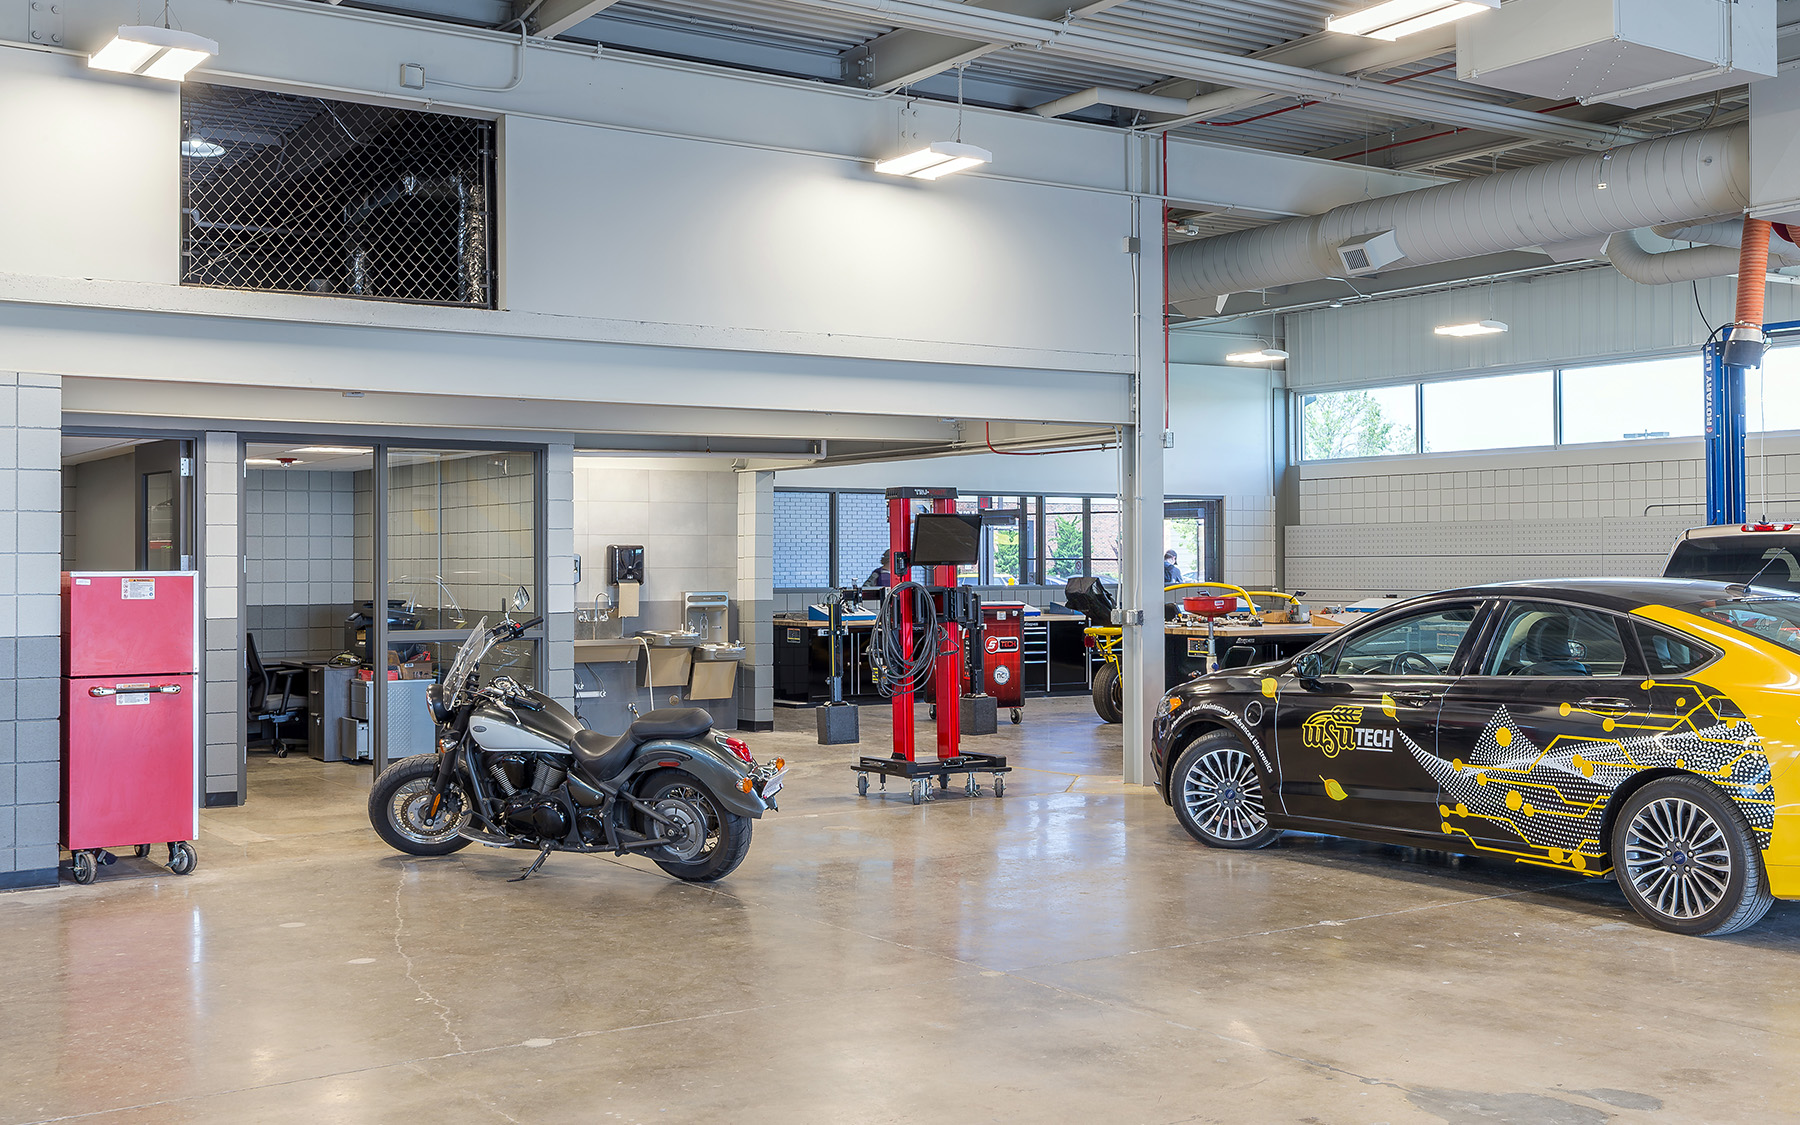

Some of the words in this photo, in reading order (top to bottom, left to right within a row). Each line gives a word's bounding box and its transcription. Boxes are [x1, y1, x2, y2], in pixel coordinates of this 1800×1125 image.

[1705, 345, 1713, 371] LIFT
[1705, 375, 1713, 426] ROTARY
[1000, 640, 1017, 648] TECH
[1202, 703, 1231, 716] Maintenance
[1233, 716, 1255, 740] Advanced
[1252, 736, 1273, 774] Electronics
[1355, 728, 1394, 748] TECH
